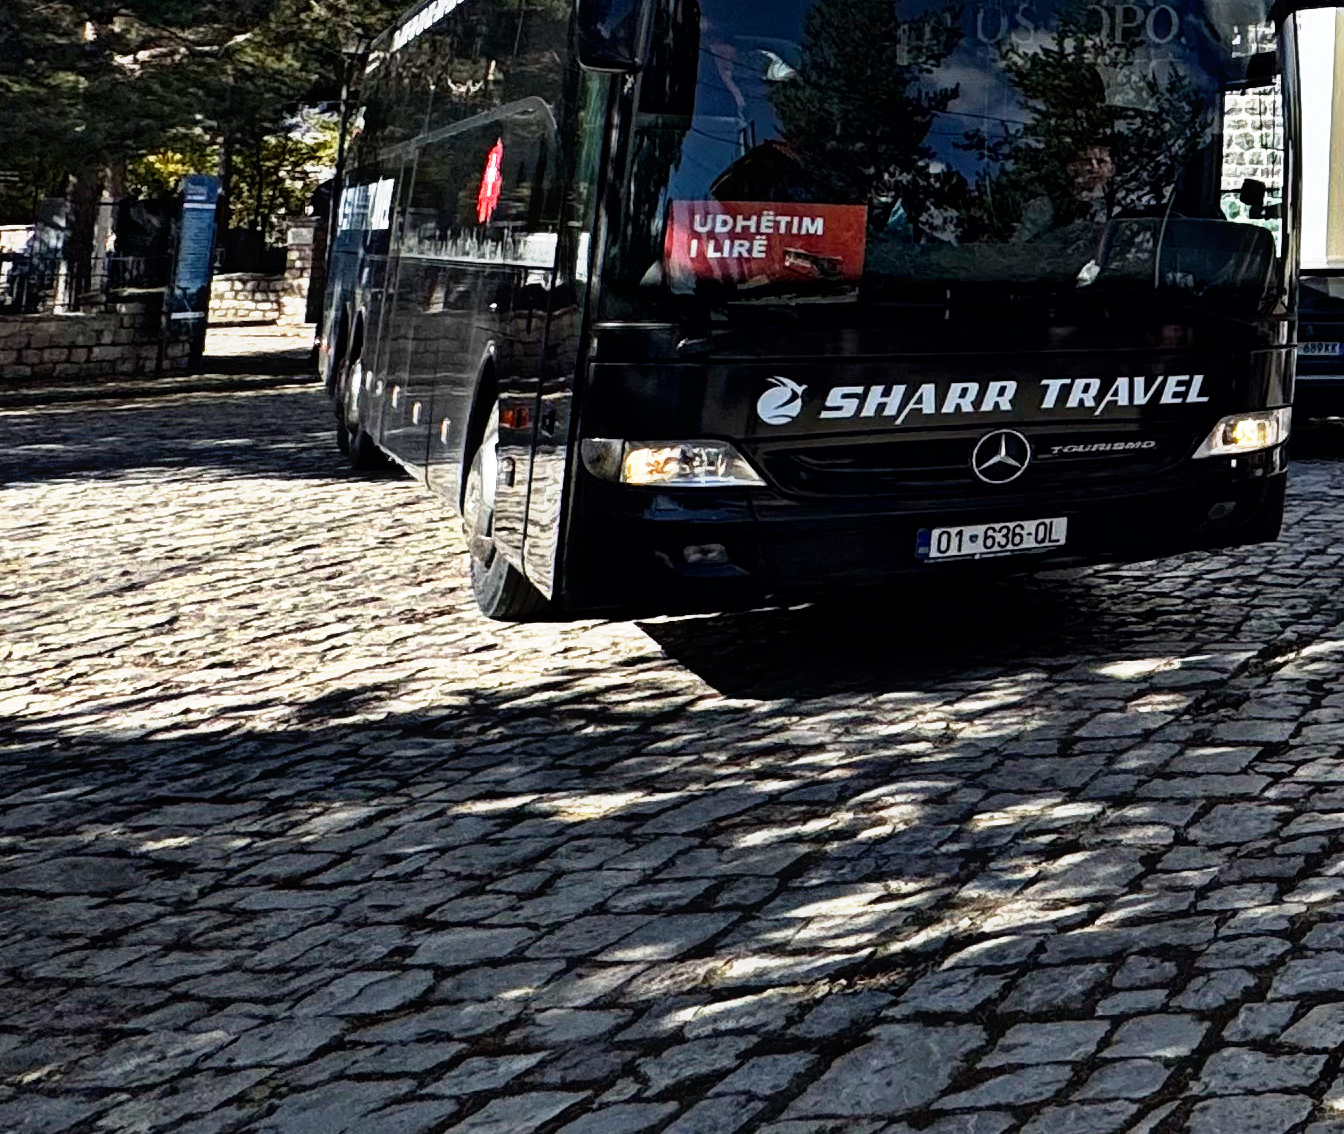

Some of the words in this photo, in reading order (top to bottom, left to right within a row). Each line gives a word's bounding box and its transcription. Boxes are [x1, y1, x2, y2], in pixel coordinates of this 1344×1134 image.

[692, 210, 825, 235] UDHËTIM
[689, 238, 698, 258] I
[706, 235, 768, 259] LIRË
[819, 381, 1018, 425] SHARR
[1039, 374, 1210, 416] TRAVEL
[1050, 440, 1156, 454] TOURISMO
